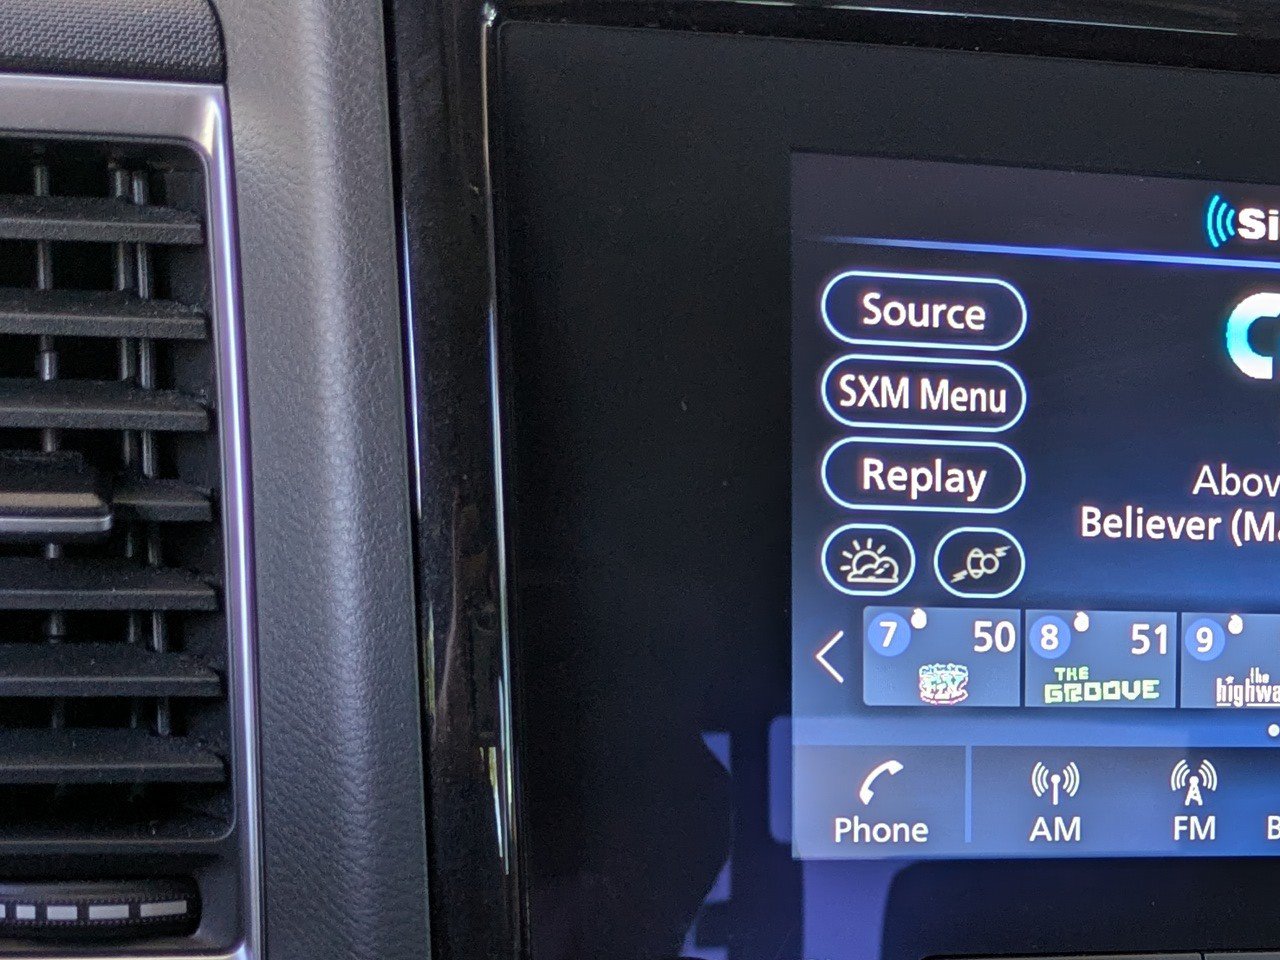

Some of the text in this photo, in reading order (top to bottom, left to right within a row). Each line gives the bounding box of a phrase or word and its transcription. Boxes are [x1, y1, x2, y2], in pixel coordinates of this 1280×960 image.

[862, 292, 986, 330] Source
[839, 374, 1006, 413] SXM Menu
[862, 458, 987, 502] Replay
[1080, 505, 1222, 541] Believer
[879, 621, 898, 648] 7
[973, 620, 1016, 653] 50
[1040, 624, 1059, 650] 8
[1131, 623, 1168, 655] 51
[1196, 626, 1213, 653] 9
[1054, 666, 1089, 681] THE
[1250, 667, 1270, 684] the
[1044, 680, 1160, 703] GROOVE
[834, 816, 929, 843] Phone
[1029, 816, 1081, 842] AM
[1174, 815, 1217, 840] FM
